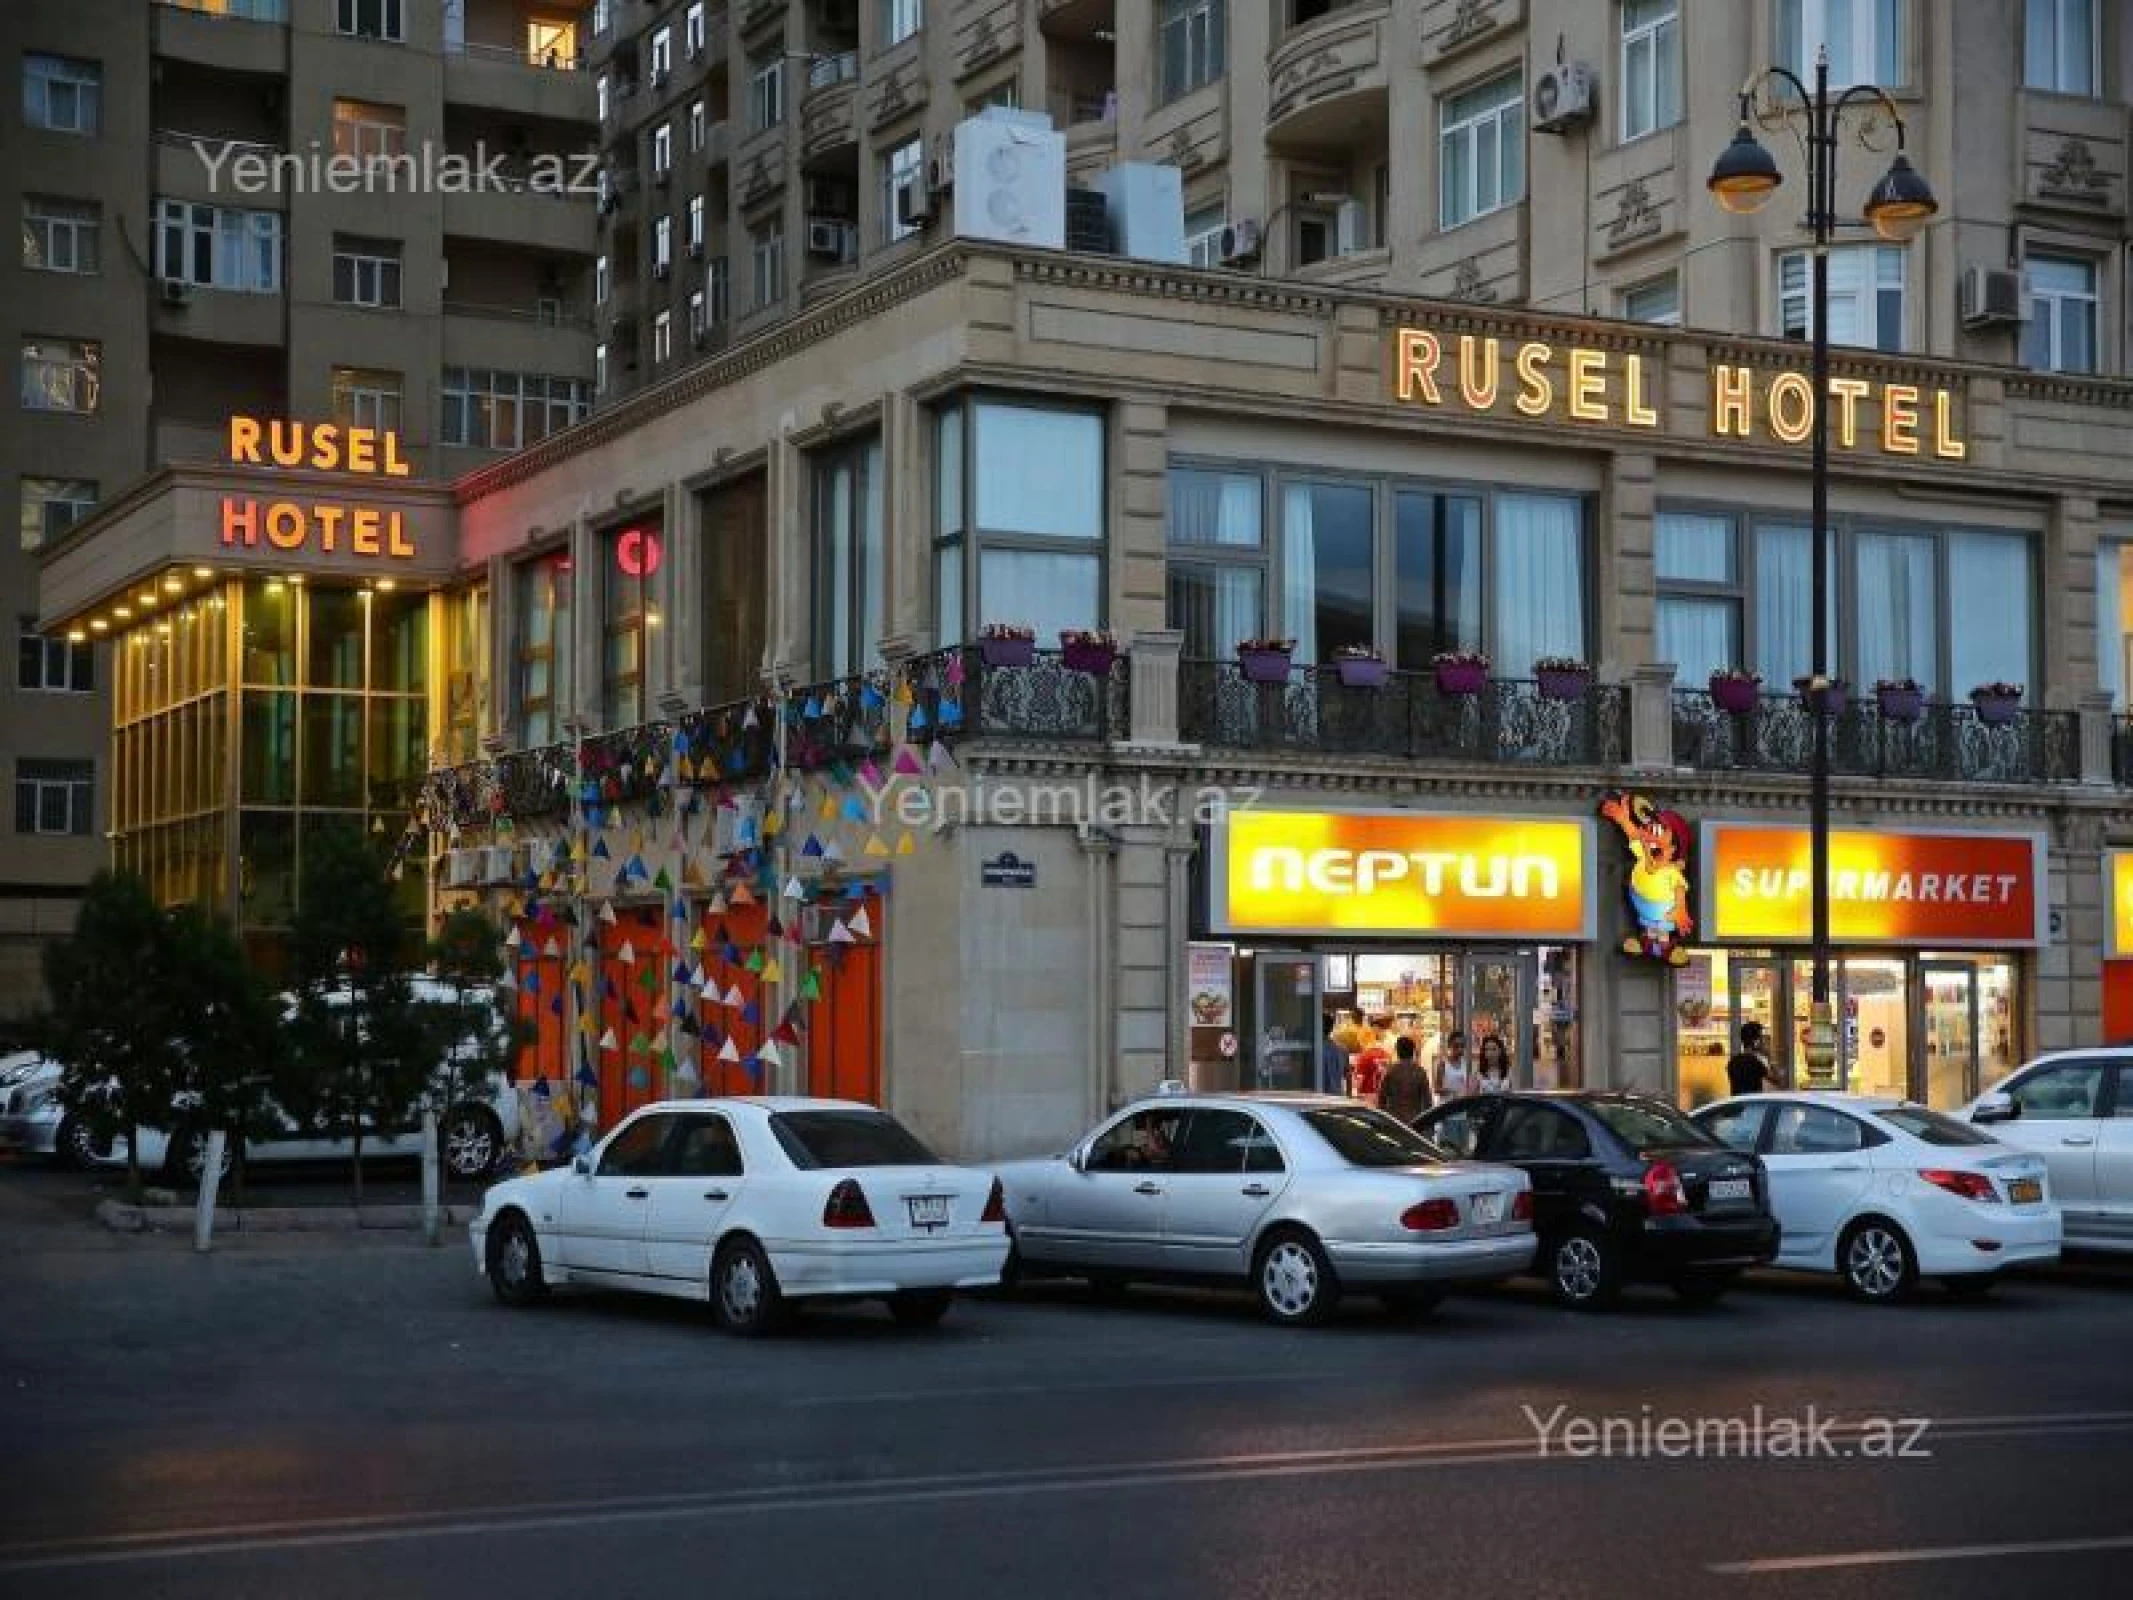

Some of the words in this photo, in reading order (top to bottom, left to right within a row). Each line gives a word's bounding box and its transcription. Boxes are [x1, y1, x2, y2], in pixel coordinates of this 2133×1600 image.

[1398, 327, 1657, 427] RUSEL
[1715, 364, 1966, 457] HOTEL
[231, 415, 409, 476] RUSEL
[222, 497, 414, 556] HOTEL
[1733, 865, 2018, 904] SUPRMARKET
